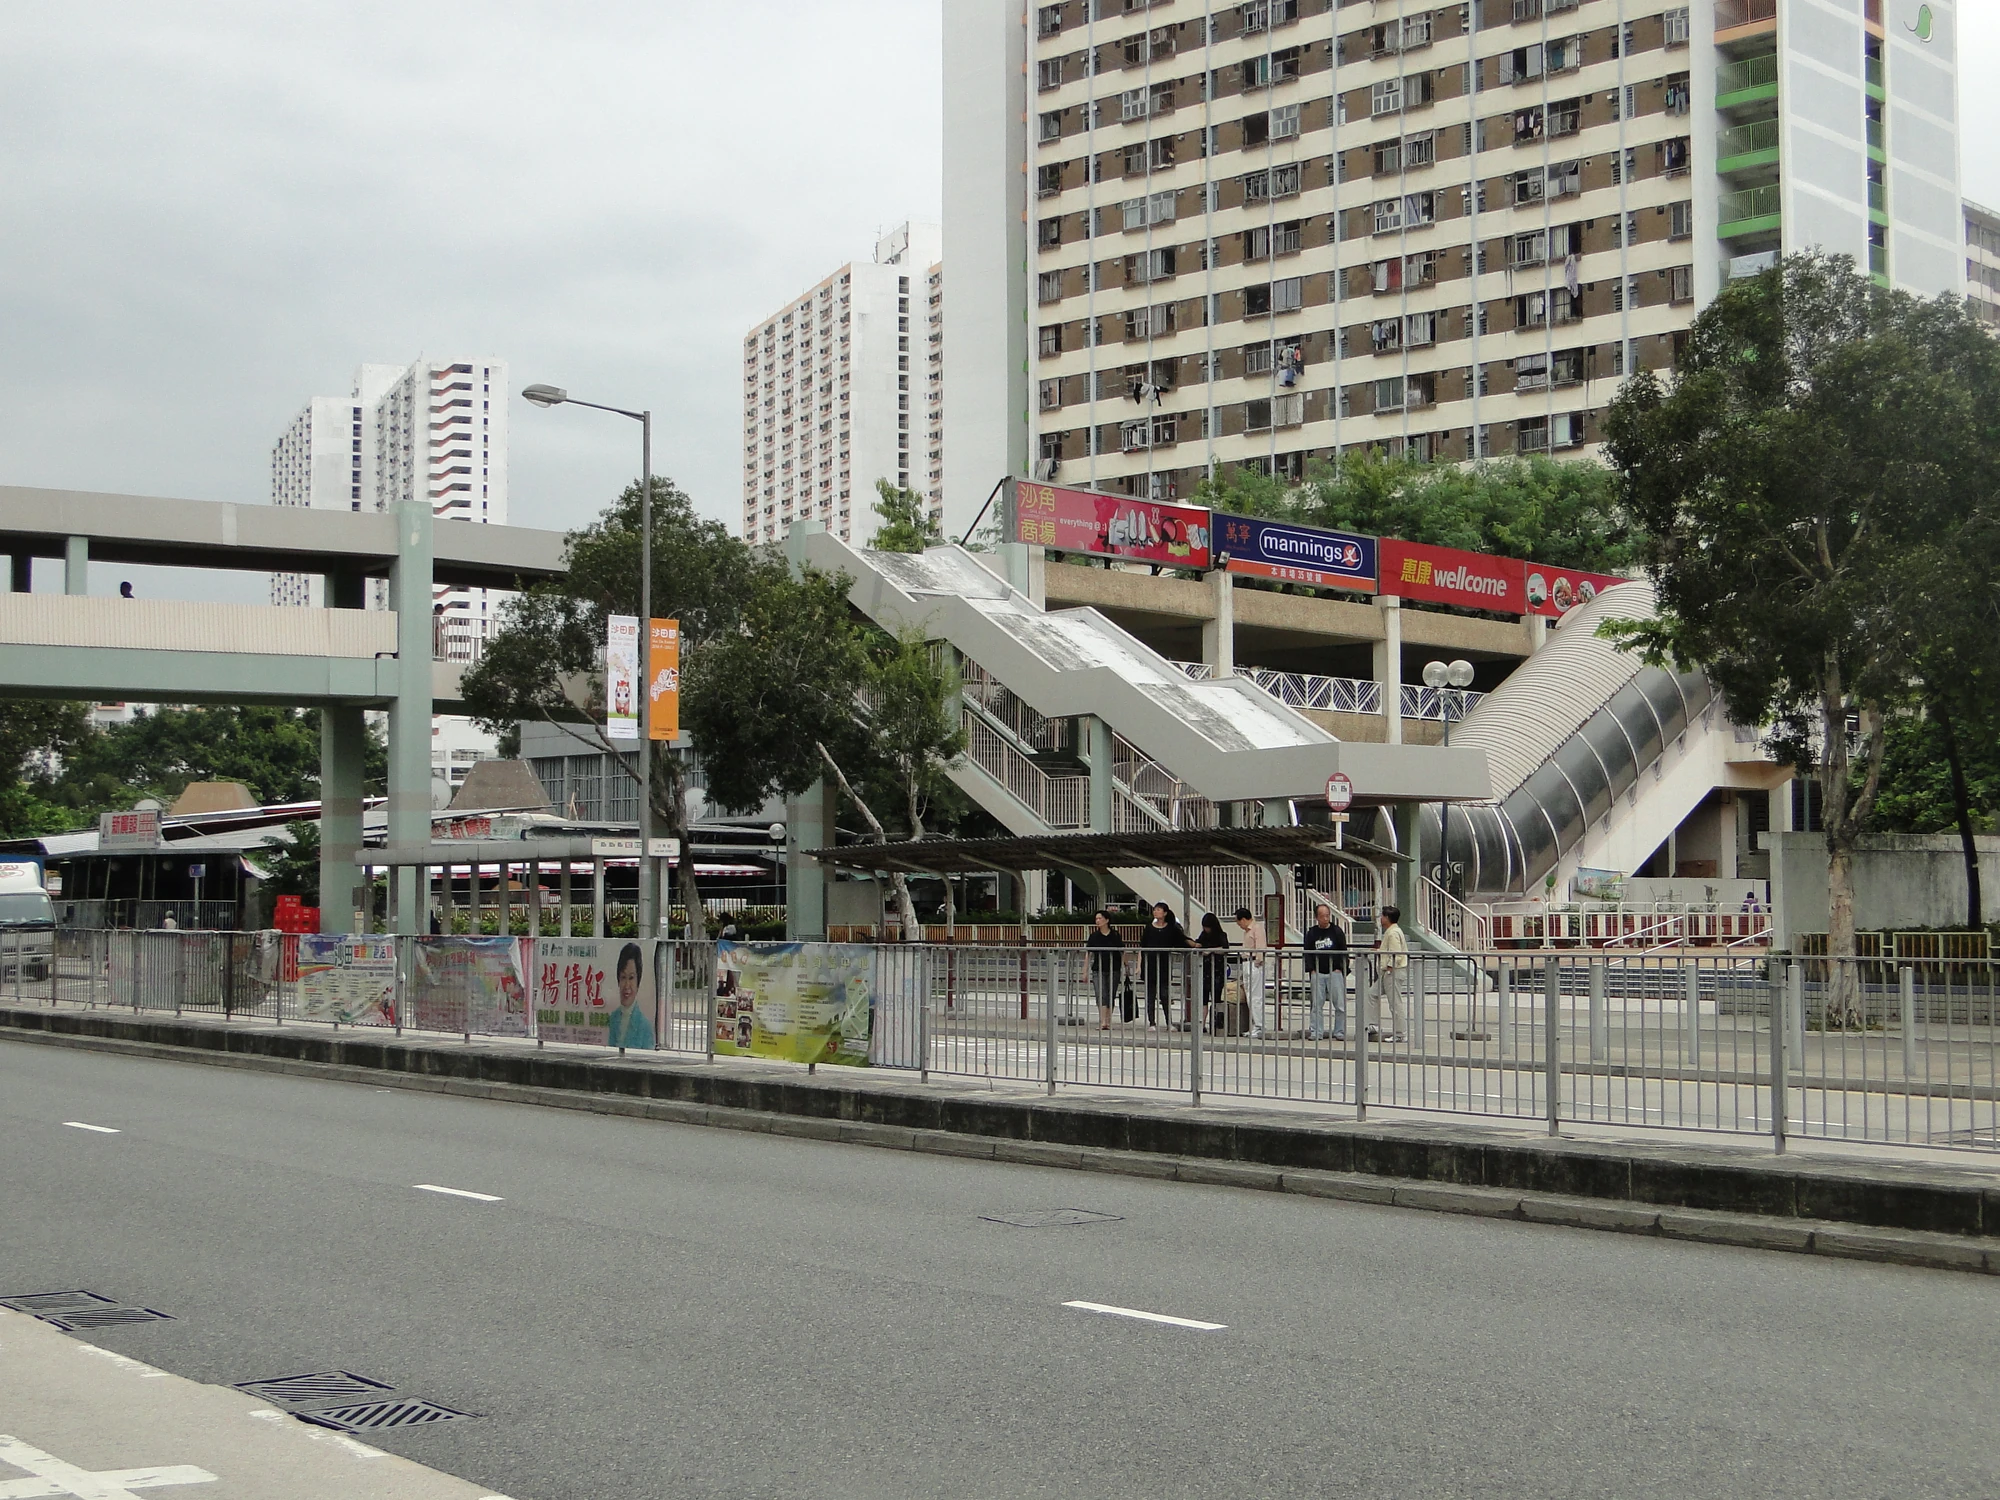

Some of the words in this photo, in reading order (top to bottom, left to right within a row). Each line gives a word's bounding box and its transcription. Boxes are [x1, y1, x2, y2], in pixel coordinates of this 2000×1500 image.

[1020, 484, 1055, 511] 沙角
[1020, 518, 1056, 545] 商場
[1059, 518, 1093, 530] everything
[1226, 522, 1250, 544] 萬寧
[1263, 535, 1342, 562] mannings
[1400, 558, 1432, 585] 惠康
[1433, 566, 1507, 597] wellcome
[541, 963, 604, 1006] 楊倩紅
